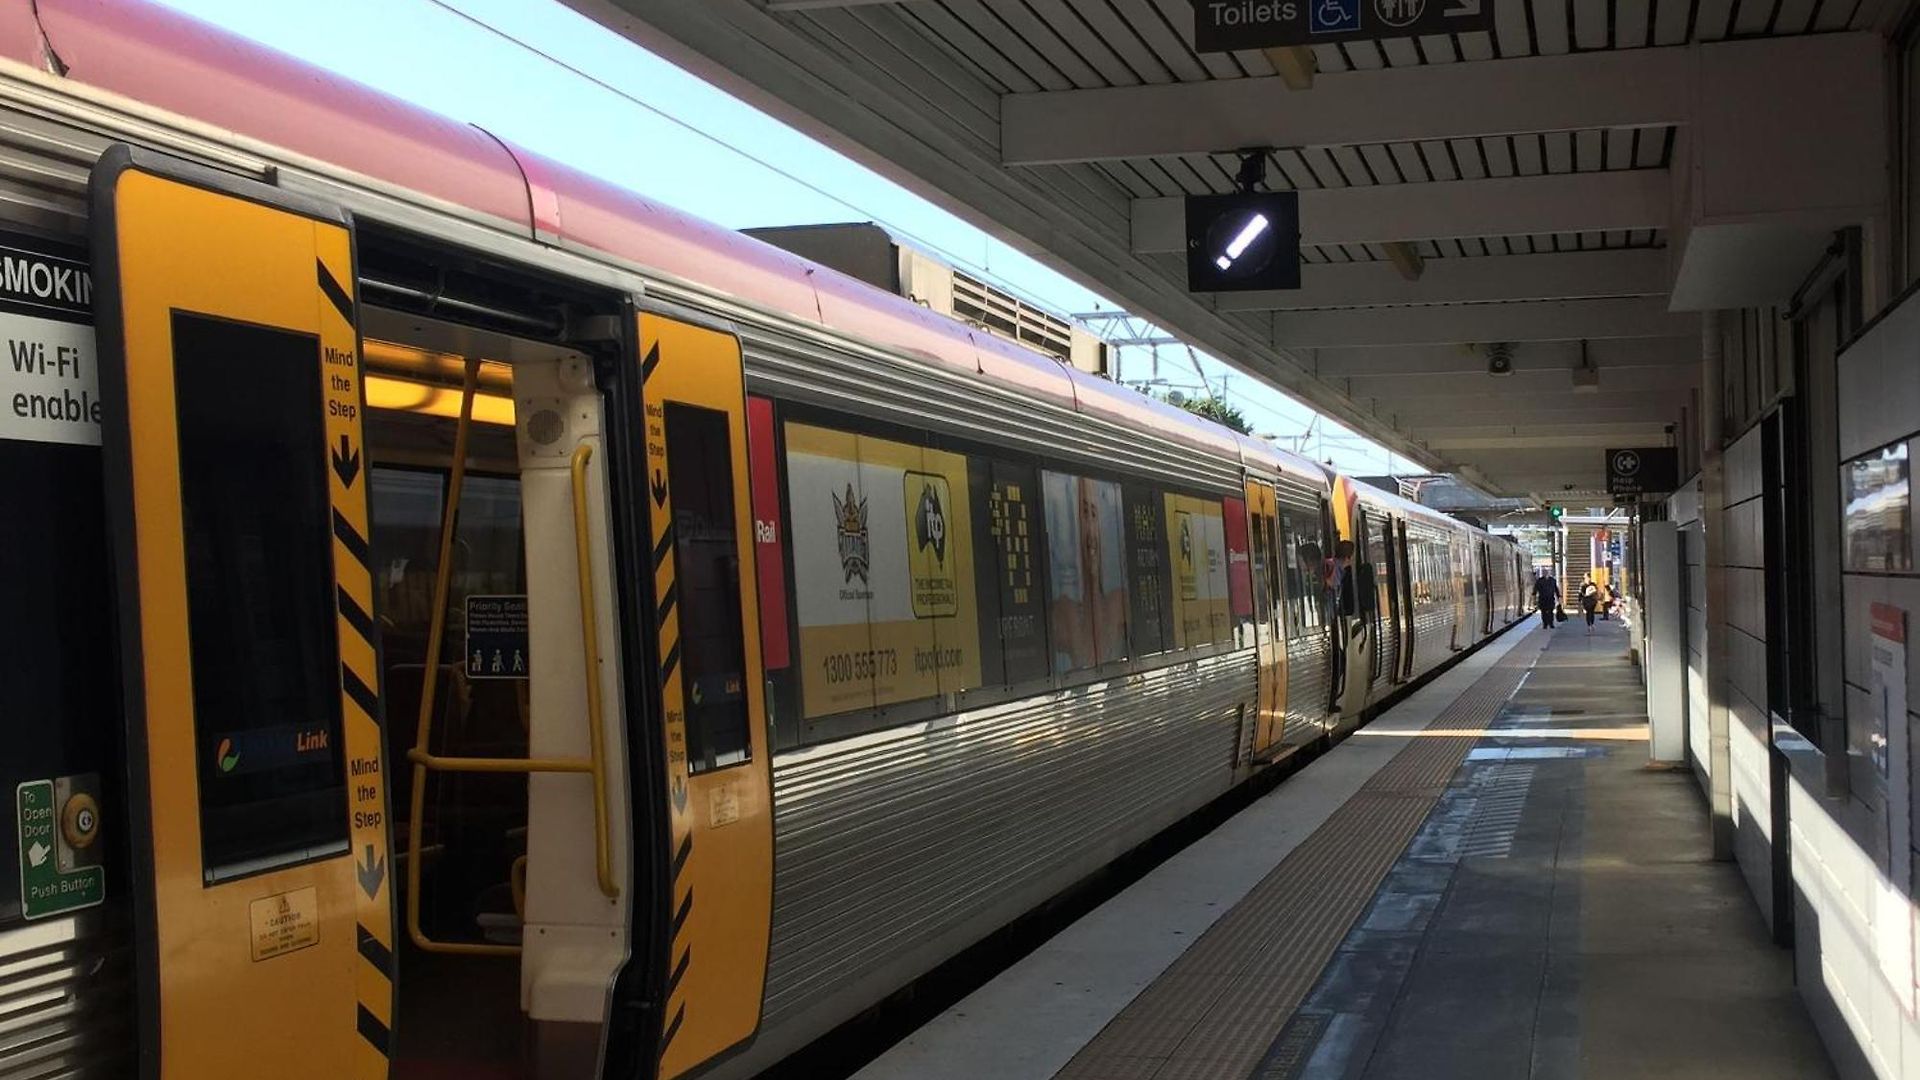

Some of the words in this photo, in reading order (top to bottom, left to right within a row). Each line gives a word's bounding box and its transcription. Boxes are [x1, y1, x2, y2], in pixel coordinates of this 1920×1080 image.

[1208, 0, 1298, 26] Toilets
[8, 339, 79, 379] Wi-Fi
[325, 347, 353, 367] Mind
[331, 374, 351, 392] the
[328, 400, 356, 421] Step
[756, 520, 776, 543] Rail
[823, 655, 853, 684] 1300
[855, 651, 876, 679] 555
[878, 648, 898, 677] 773
[297, 729, 328, 752] Link
[351, 757, 379, 776] Mind
[23, 791, 36, 802] To
[357, 784, 376, 802] the
[23, 808, 52, 821] Open
[354, 811, 382, 829] Step
[24, 825, 51, 838] Door
[31, 884, 58, 899] Push
[61, 877, 95, 893] Button
